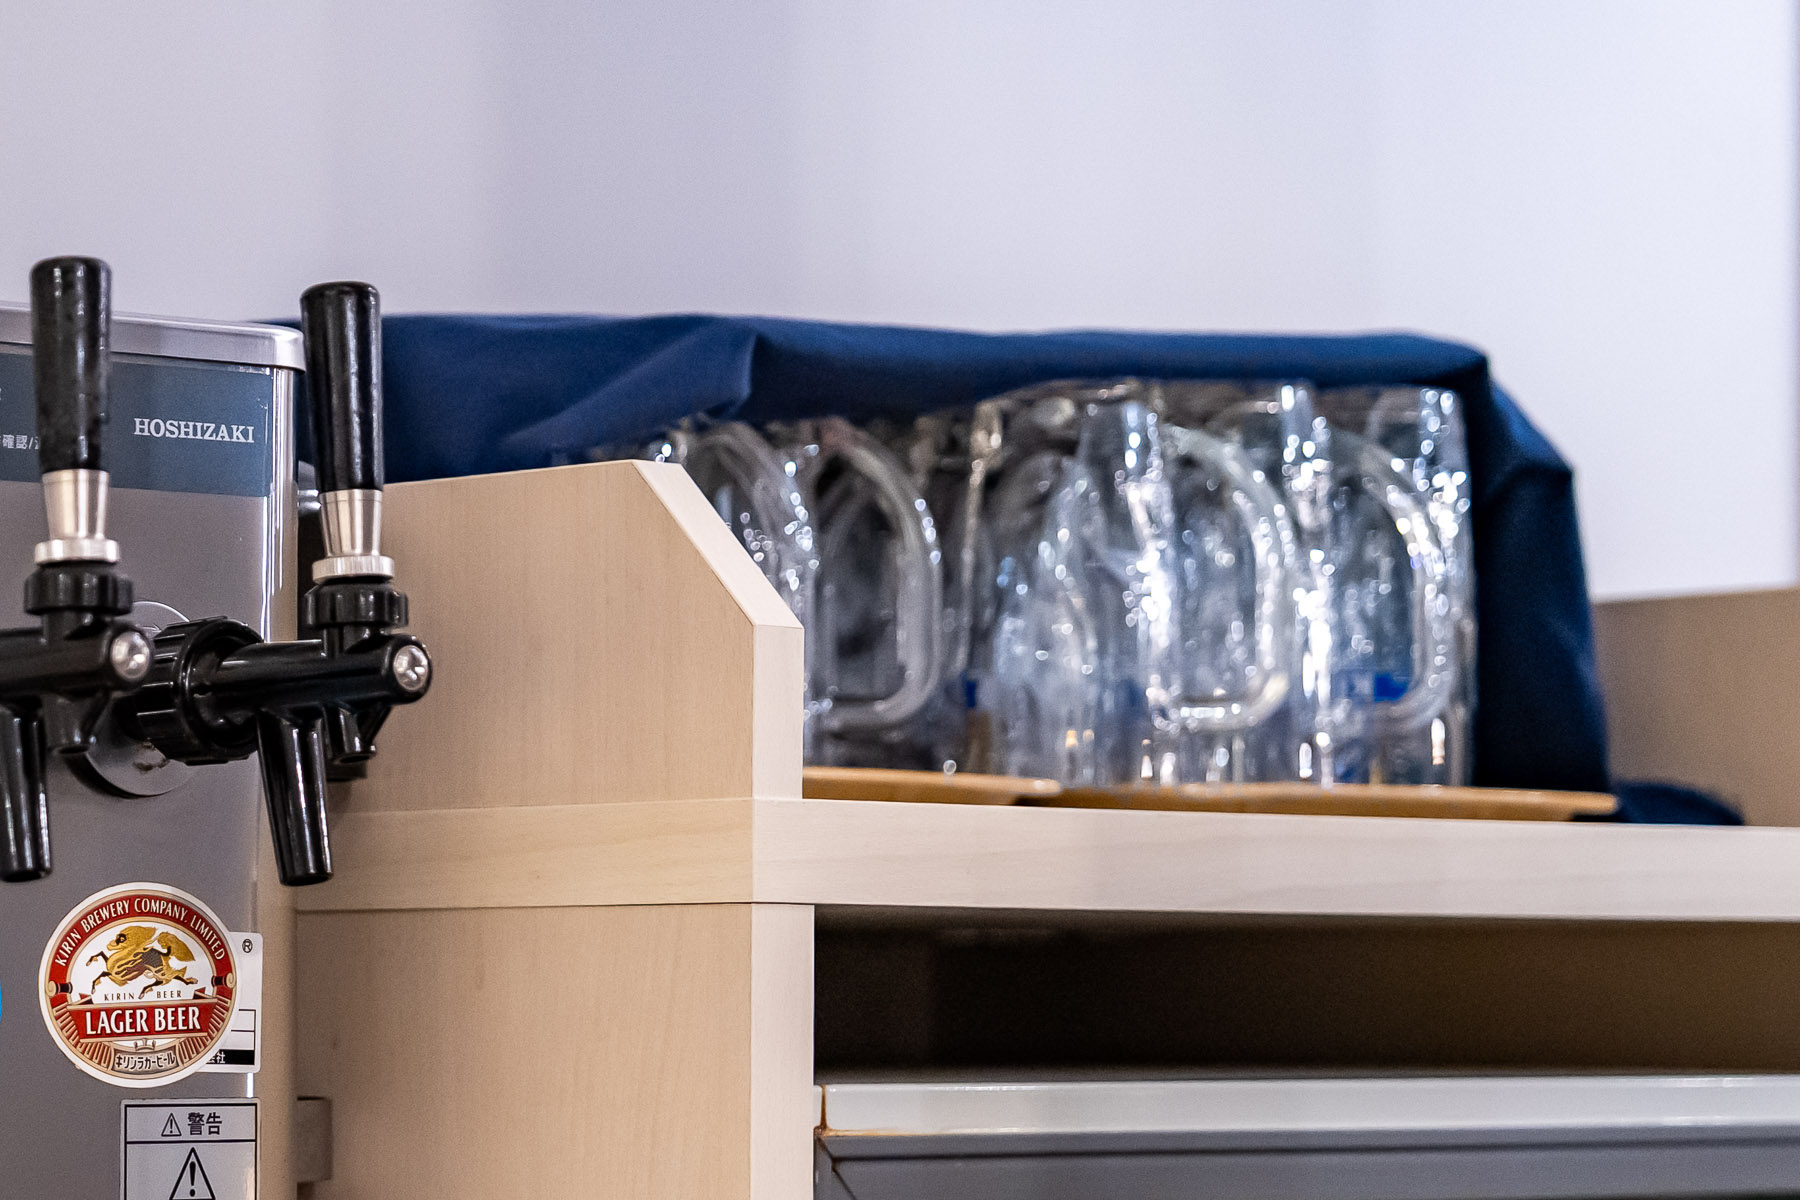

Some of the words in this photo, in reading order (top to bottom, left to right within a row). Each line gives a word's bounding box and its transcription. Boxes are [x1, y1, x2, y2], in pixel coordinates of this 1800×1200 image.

[133, 417, 255, 444] HOSHIZAKI
[54, 931, 82, 967] KIRIN
[80, 899, 131, 933] BREWERY
[189, 915, 226, 961] LIMITED
[103, 991, 135, 1002] KIRIN
[156, 989, 183, 999] BEER
[85, 1009, 149, 1035] LAGER
[154, 1006, 201, 1032] BEER
[115, 1052, 176, 1070] キリンラガービール
[188, 1112, 222, 1136] 警告
